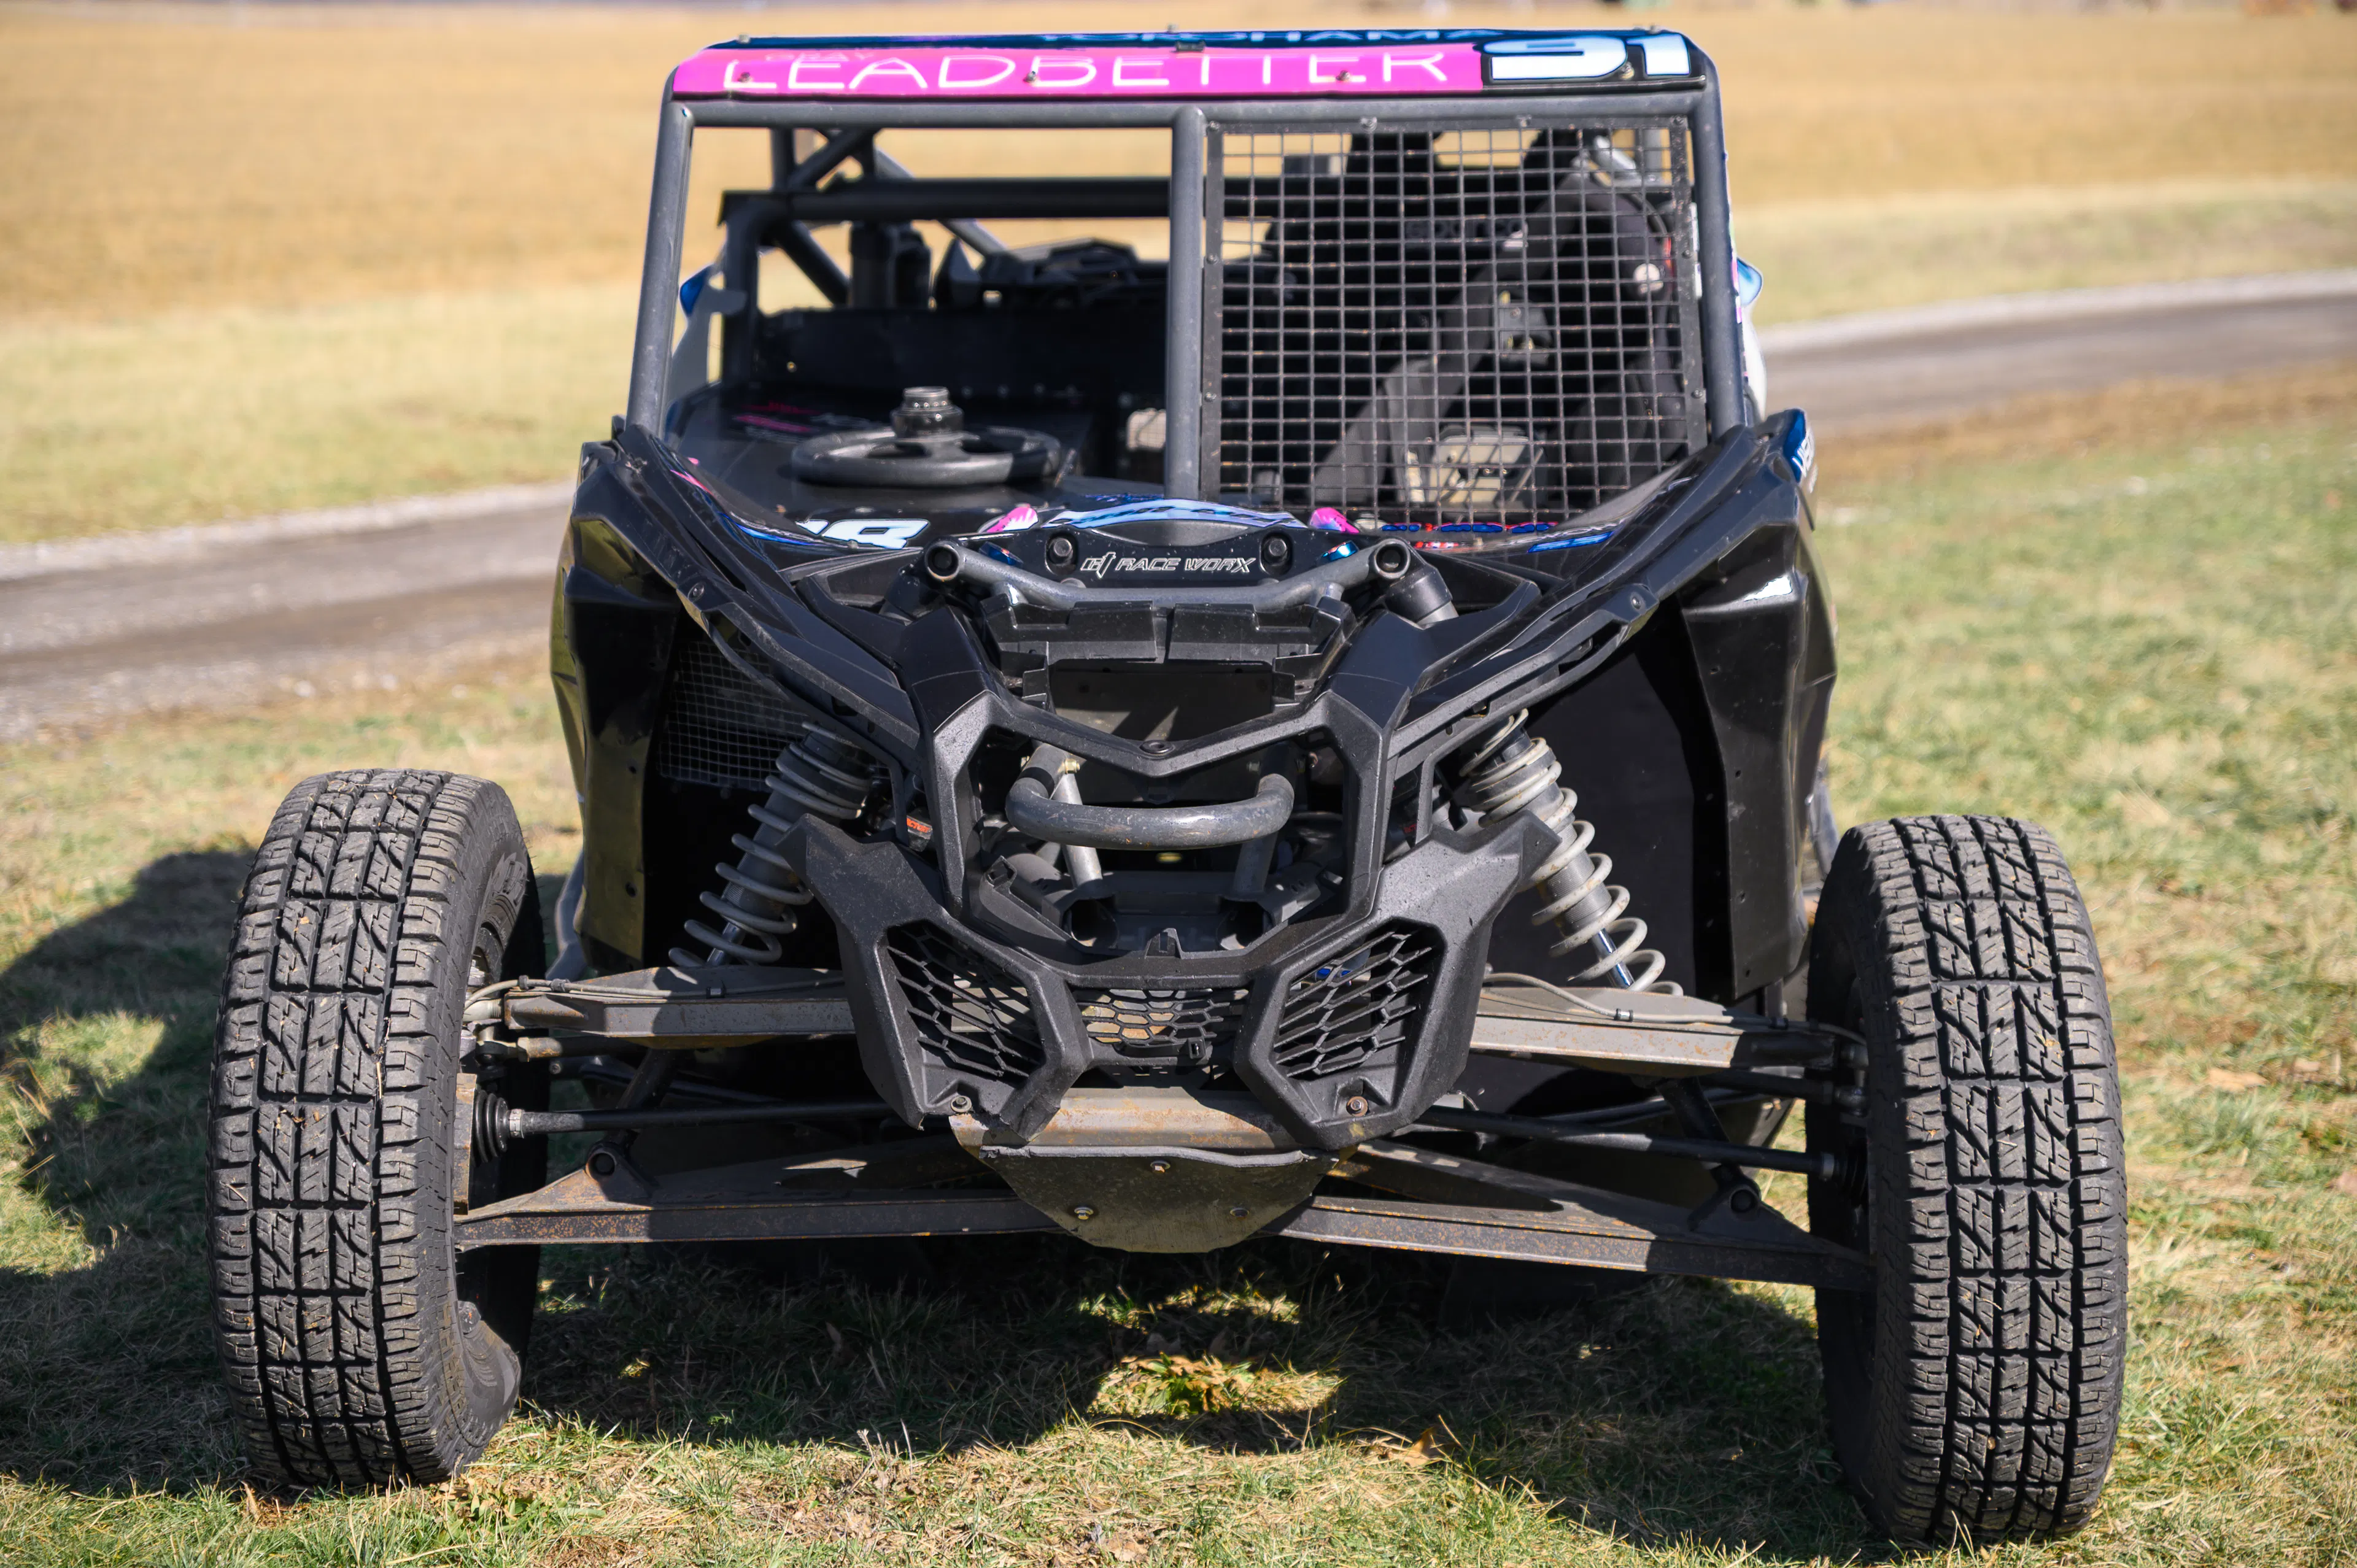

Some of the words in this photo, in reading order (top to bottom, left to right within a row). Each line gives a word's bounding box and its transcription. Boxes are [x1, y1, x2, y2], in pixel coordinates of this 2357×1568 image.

[723, 52, 1447, 90] LEADBETTER
[1115, 557, 1182, 571] RACE
[1184, 557, 1257, 573] WORX
